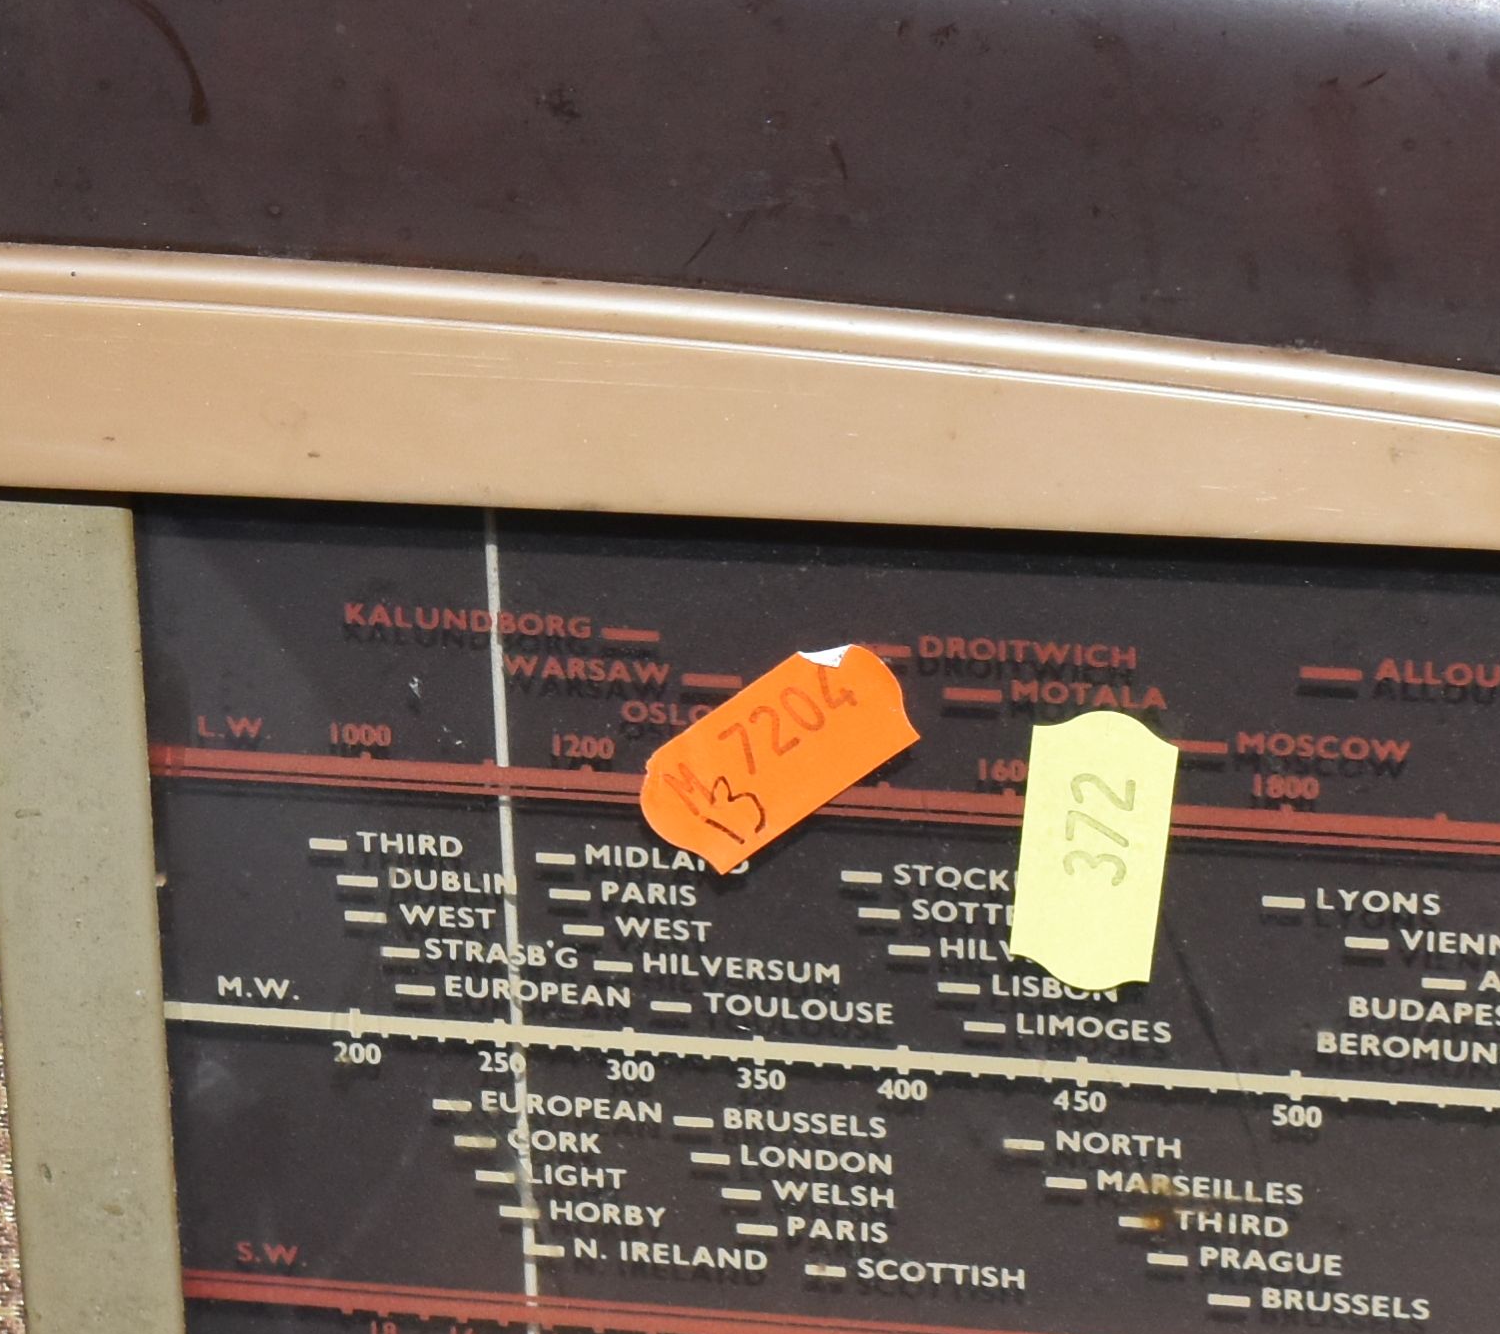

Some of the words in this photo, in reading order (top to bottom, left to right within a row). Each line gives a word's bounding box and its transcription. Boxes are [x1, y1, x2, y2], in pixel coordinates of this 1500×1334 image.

[344, 603, 592, 639] KALUNDBORG
[919, 635, 1137, 668] DROITWICH
[502, 654, 670, 684] WARSAW
[1011, 680, 1167, 710] MOTALA
[330, 722, 392, 747] 1000
[552, 734, 615, 759] 1200
[1252, 774, 1319, 800] 1800
[1235, 732, 1411, 763] MOSCOW
[1062, 772, 1136, 886] 372
[356, 831, 463, 858] THIRD
[389, 867, 517, 895] DUBLIN
[601, 881, 697, 907] PARIS
[400, 904, 496, 931] WEST
[1316, 889, 1441, 916] LYONS
[615, 917, 712, 943] WEST
[424, 937, 579, 970] STRASB'G
[643, 951, 841, 985] HILVERSUM
[217, 976, 300, 1001] M.W.
[444, 977, 631, 1008] EUROPEAN
[703, 992, 894, 1026] TOULOUSE
[1017, 1012, 1172, 1044] LIMOGES
[333, 1041, 382, 1065] 200
[479, 1050, 526, 1075] 250
[606, 1059, 656, 1083] 300
[736, 1067, 787, 1092] 350
[877, 1078, 928, 1102] 400
[1053, 1089, 1107, 1114] 450
[1271, 1103, 1323, 1129] 500
[481, 1090, 663, 1124] EUROPEAN
[723, 1109, 887, 1139] BRUSSELS
[507, 1129, 601, 1155] CORK
[1056, 1130, 1182, 1160] NORTH
[740, 1144, 893, 1176] LONDON
[527, 1164, 627, 1191] LIGHT
[1097, 1170, 1304, 1206] MARSEILLES
[772, 1180, 895, 1210] WELSH
[550, 1200, 666, 1228] HORBY
[1173, 1210, 1288, 1238] THIRD
[787, 1216, 889, 1243] PARIS
[236, 1241, 307, 1267] S.W.
[573, 1238, 606, 1262] N.
[620, 1241, 768, 1271] IRELAND
[1200, 1247, 1343, 1278] PRAGUE
[857, 1258, 1026, 1290] SCOTTISH
[1261, 1288, 1431, 1321] BRUSSELS
